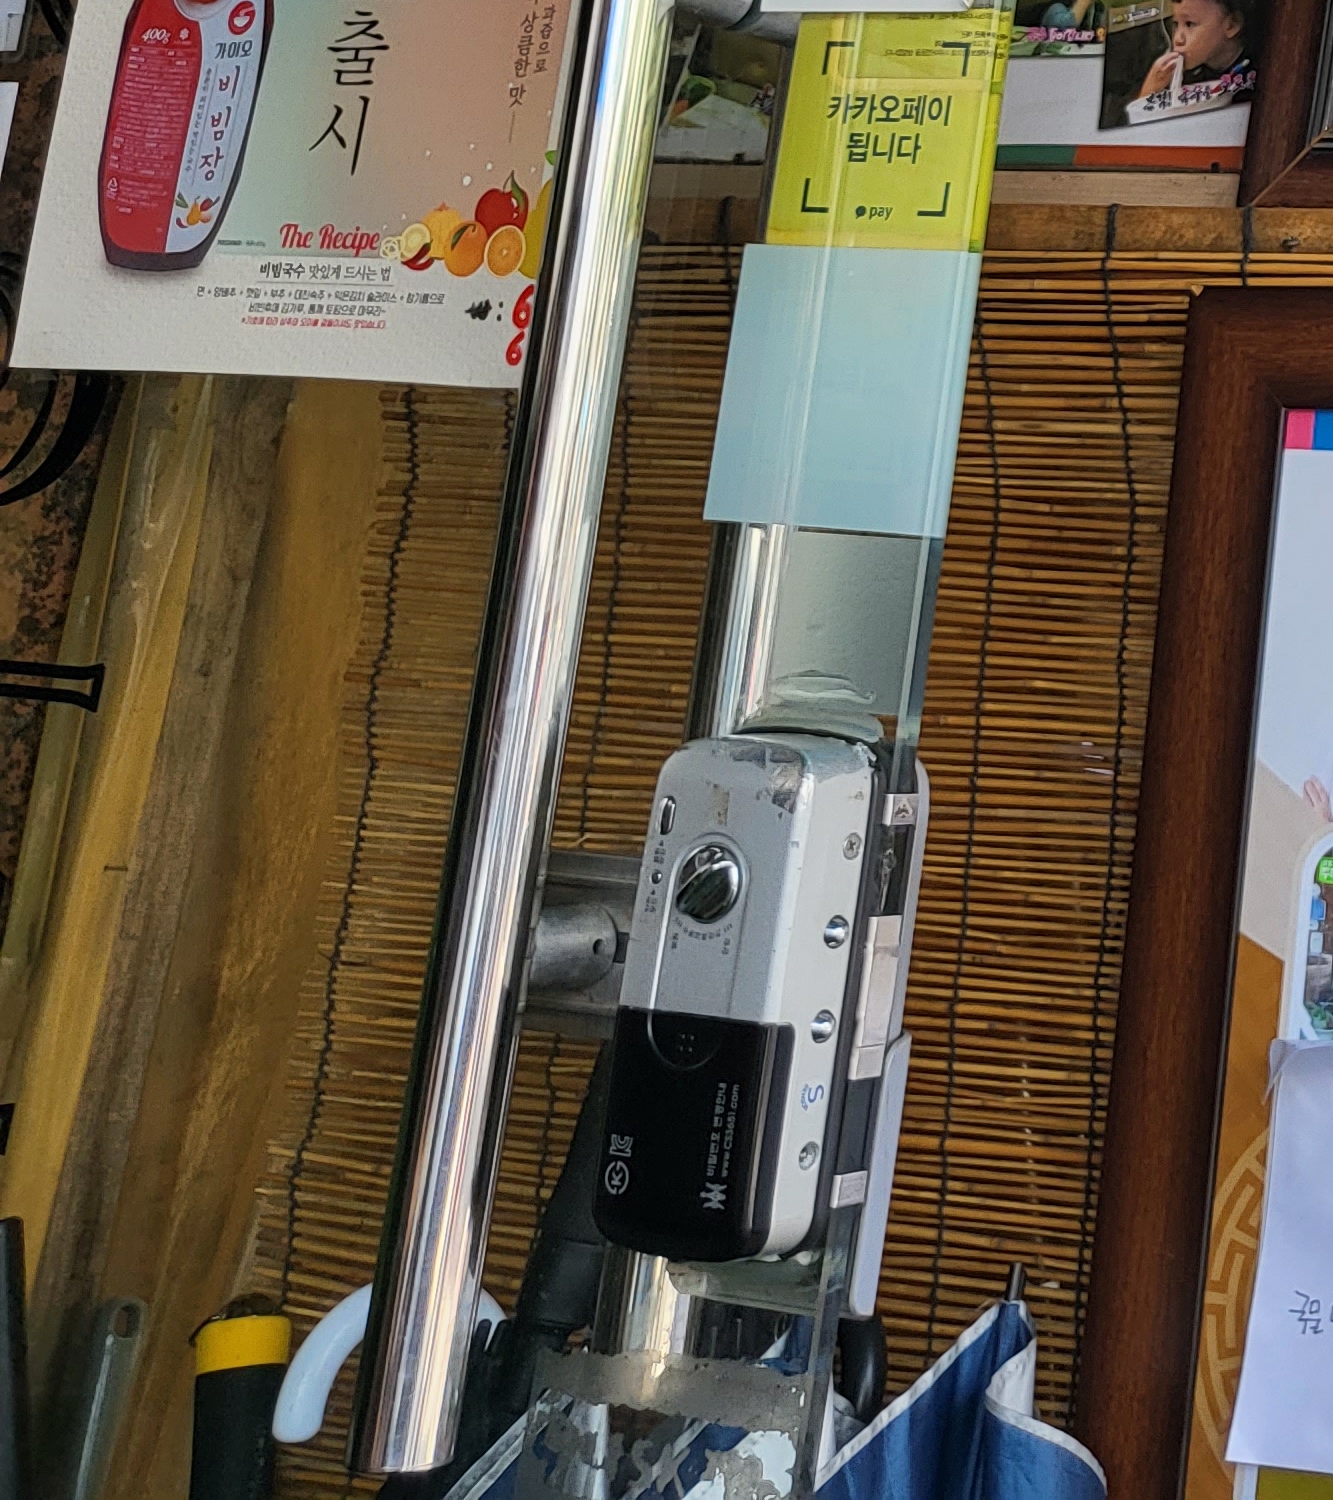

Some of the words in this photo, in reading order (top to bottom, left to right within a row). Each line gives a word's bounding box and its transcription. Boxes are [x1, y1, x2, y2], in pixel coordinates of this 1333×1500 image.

[213, 40, 253, 60] 가이오
[513, 10, 539, 79] 상큼한
[308, 9, 391, 177] 출시
[508, 82, 528, 109] 맛
[198, 64, 242, 182] 비빔장
[827, 93, 954, 129] 카카오페이
[845, 132, 923, 166] 됩니다
[868, 203, 895, 222] pay
[279, 222, 311, 249] The
[318, 223, 382, 257] Recipe
[259, 260, 306, 281] 비빔국수
[307, 264, 342, 281] 맛있게
[343, 265, 378, 282] 드시는
[380, 265, 393, 283] 법
